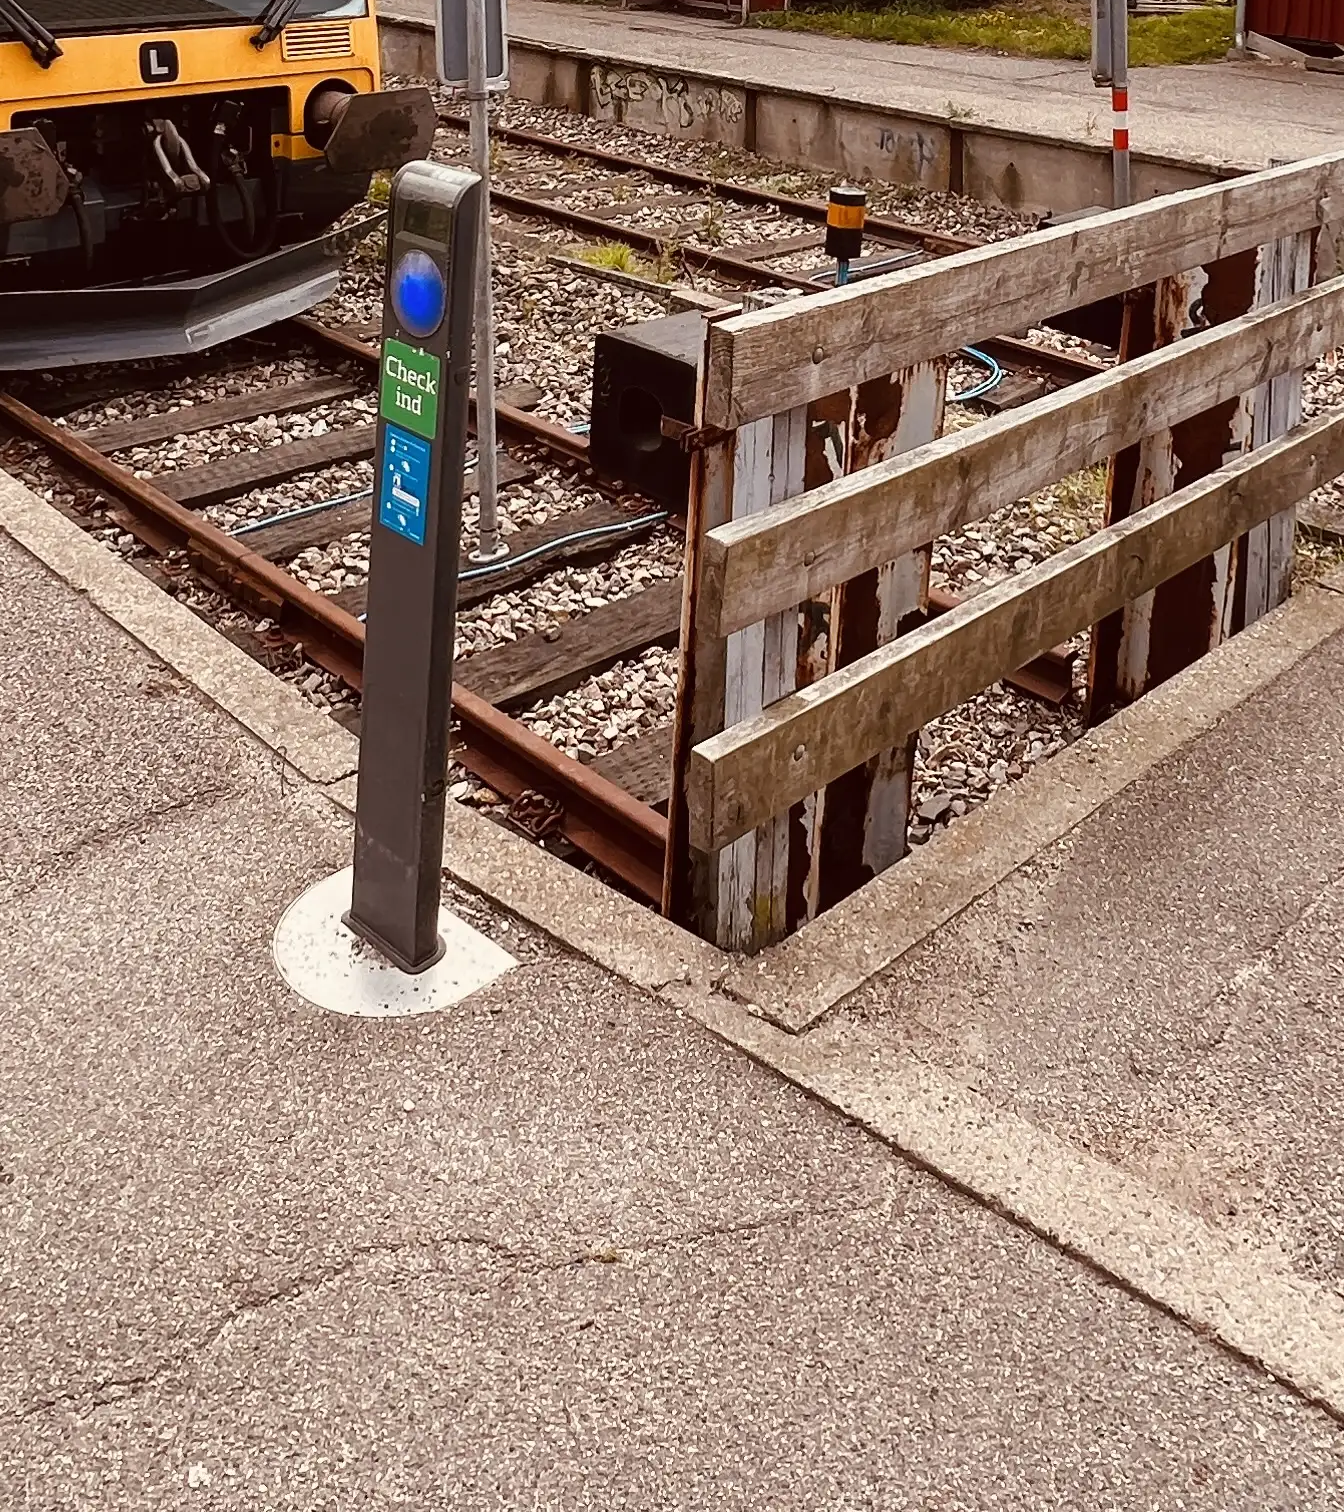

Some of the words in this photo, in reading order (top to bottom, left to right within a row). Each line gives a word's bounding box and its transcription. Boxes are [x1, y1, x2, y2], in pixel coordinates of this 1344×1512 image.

[149, 49, 169, 75] L
[385, 355, 436, 395] Check
[395, 385, 423, 416] ind
